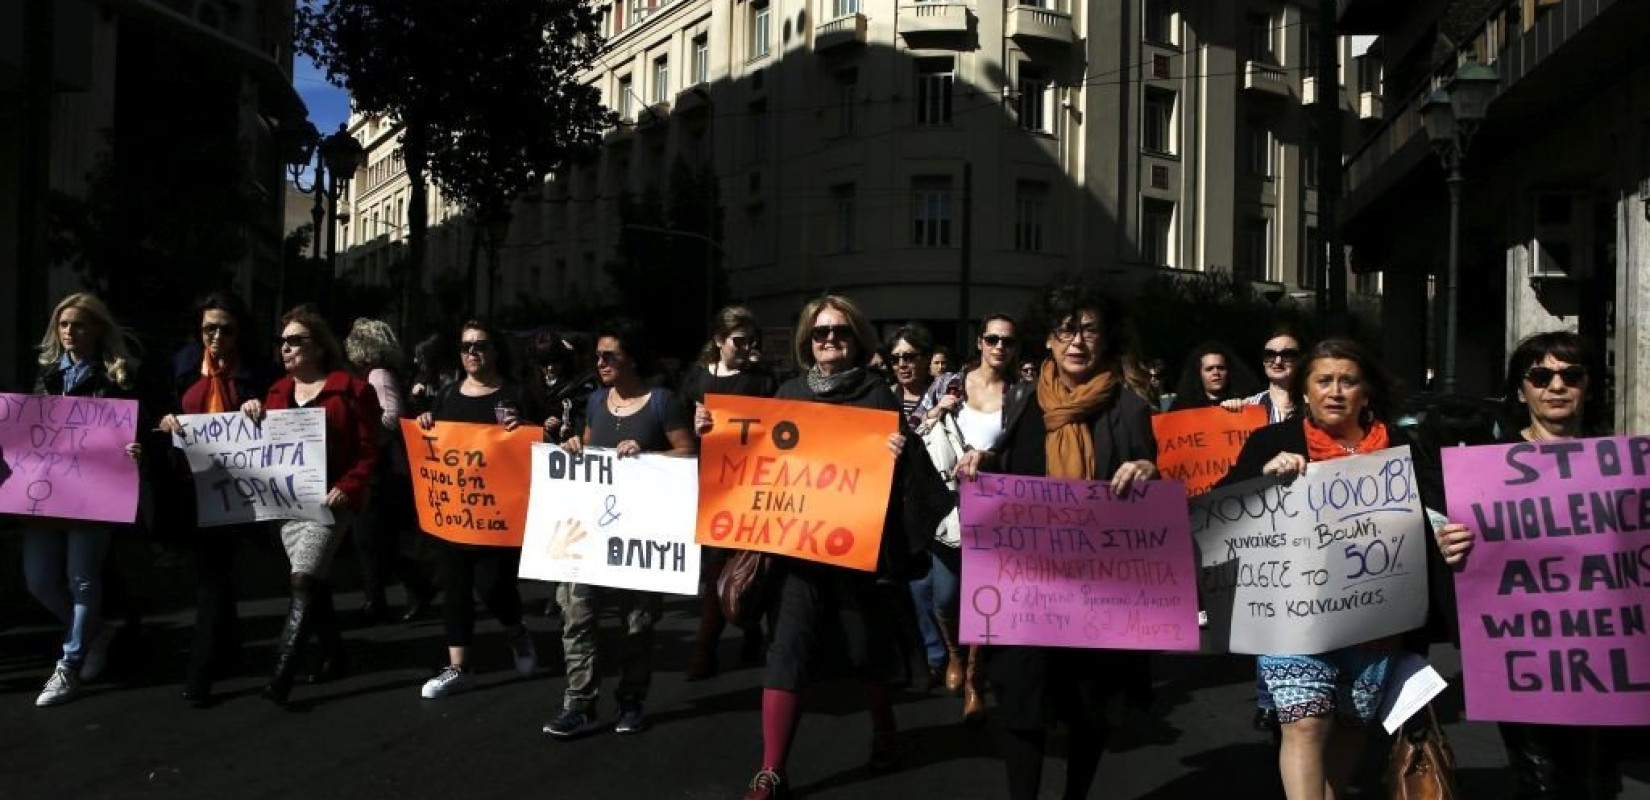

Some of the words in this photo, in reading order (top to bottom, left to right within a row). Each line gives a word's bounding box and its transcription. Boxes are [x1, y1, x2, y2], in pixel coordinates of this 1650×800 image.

[728, 418, 800, 451] ΤΟ
[549, 450, 613, 485] ΟΡΓΗ
[719, 455, 861, 495] ΜΕΛΛΟΝ
[1504, 437, 1650, 486] STOP
[751, 491, 805, 514] ΕΙΝΑΙ
[972, 476, 1079, 505] ΙΣΟΤΗΤΑ
[1086, 483, 1150, 504] ΣΤΝ
[598, 494, 621, 527] &
[1000, 503, 1098, 526] ΕΡΓΑΣΙΑ
[1471, 488, 1650, 542] VIOLENCE
[710, 510, 855, 557] ΘΗΛΥΚΟ
[963, 524, 1097, 553] ΙΣΟΤΗΤΑ
[1101, 526, 1168, 549] ΣΤΗΝ
[607, 536, 686, 573] ΘΛΙΨΗ
[1344, 534, 1406, 579] 50%
[1481, 604, 1646, 638] WOMEN
[1504, 648, 1650, 693] GIRL
